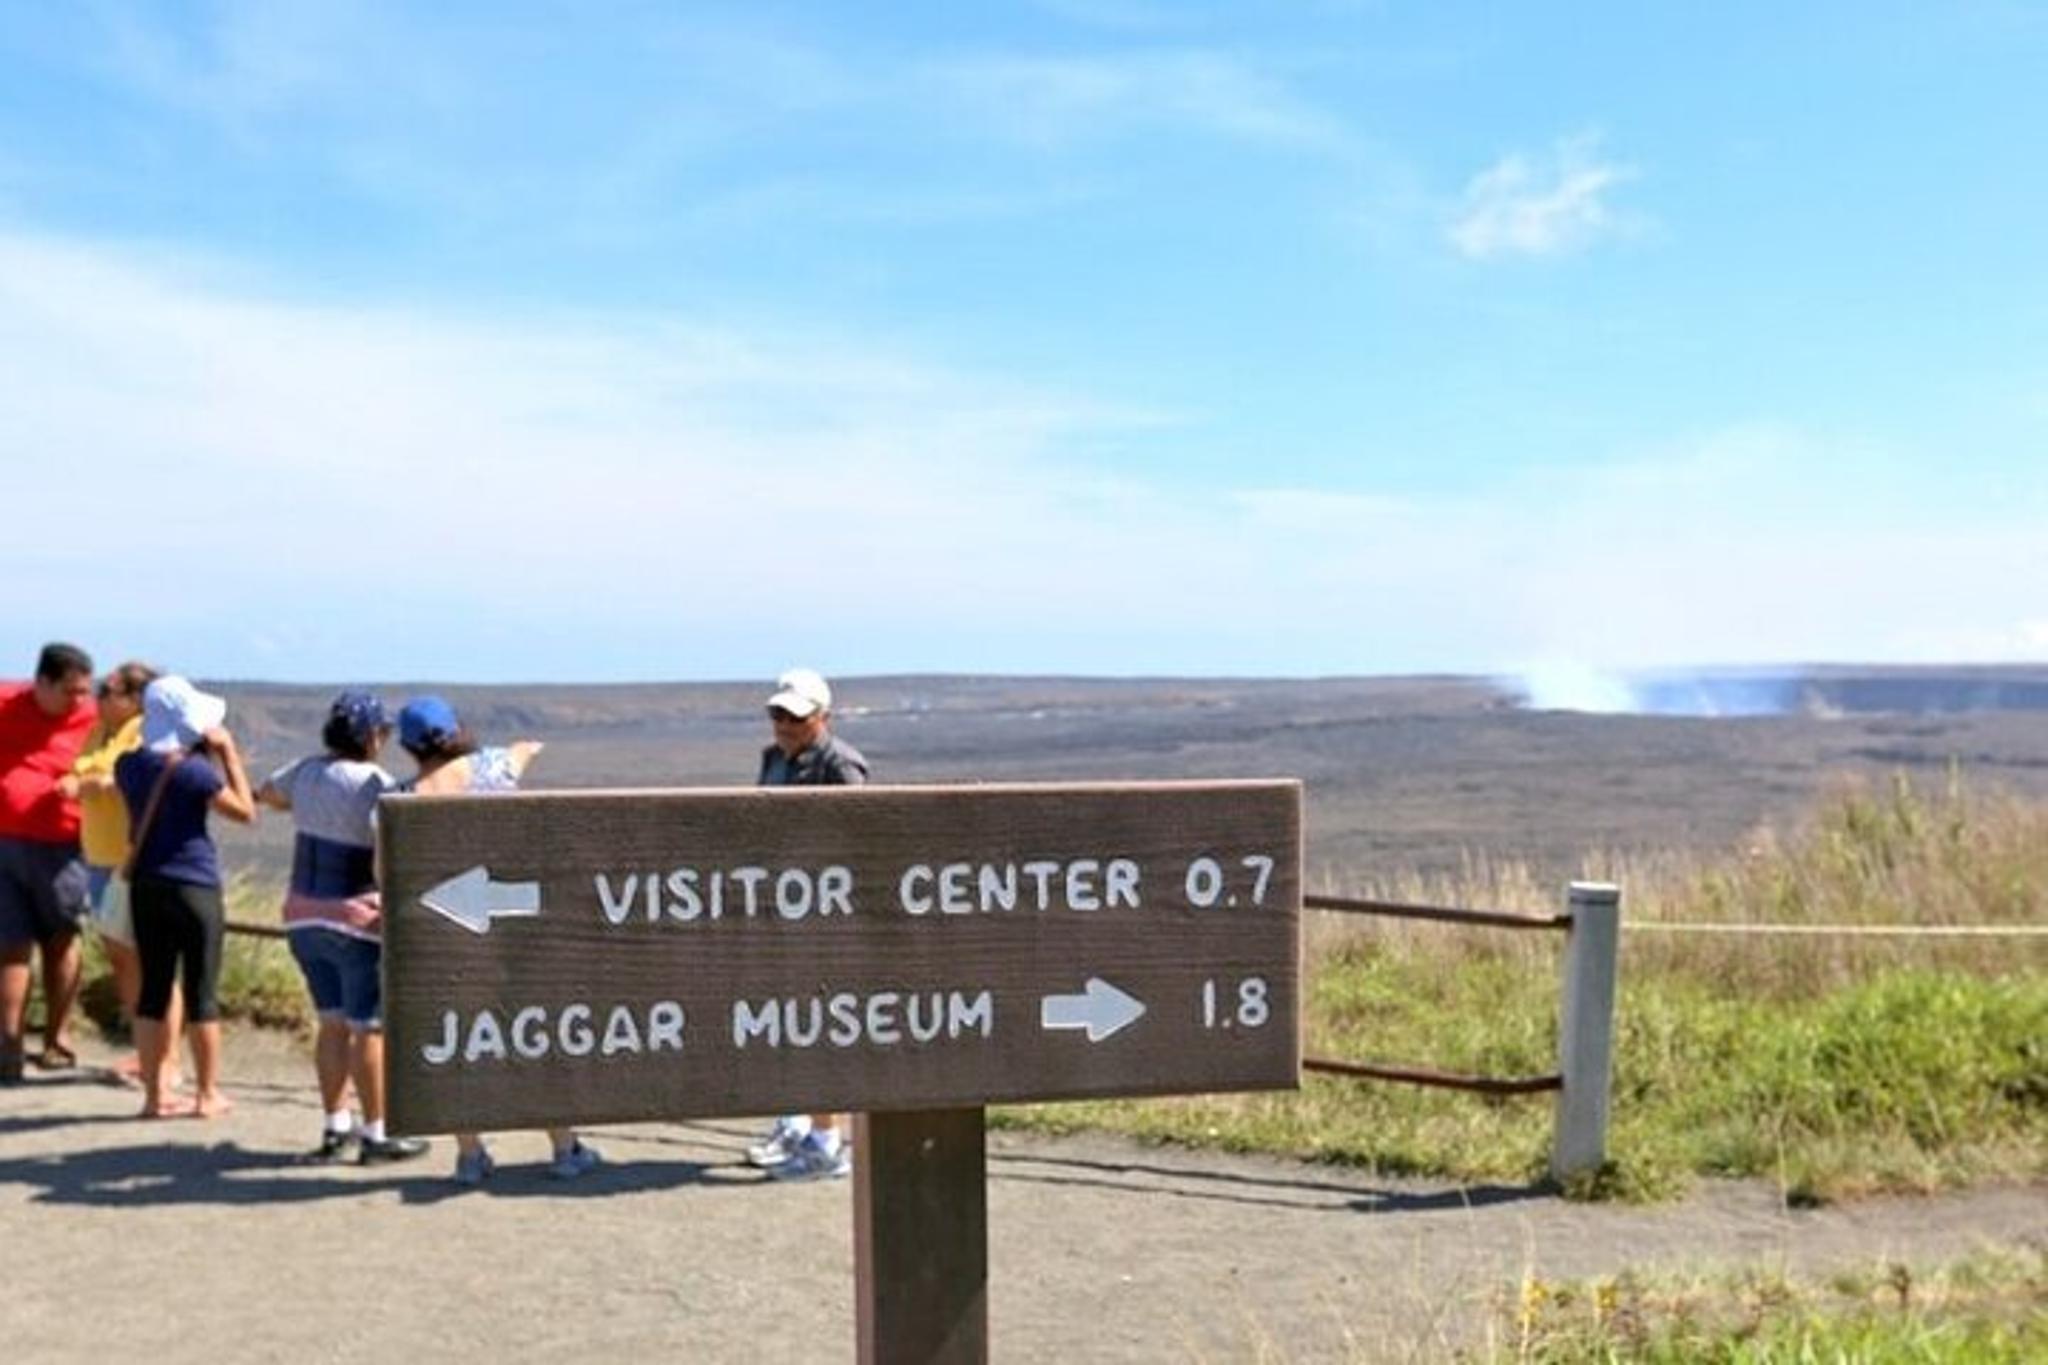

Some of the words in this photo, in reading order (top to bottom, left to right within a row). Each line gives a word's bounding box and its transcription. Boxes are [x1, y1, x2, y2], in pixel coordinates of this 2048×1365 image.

[595, 865, 853, 926] VISITOR
[899, 859, 1141, 914] CENTER
[1185, 855, 1273, 908] 0.7
[423, 1001, 684, 1064] JAGGAR
[733, 991, 994, 1047] MUSEUM
[1203, 978, 1268, 1029] 1.8
